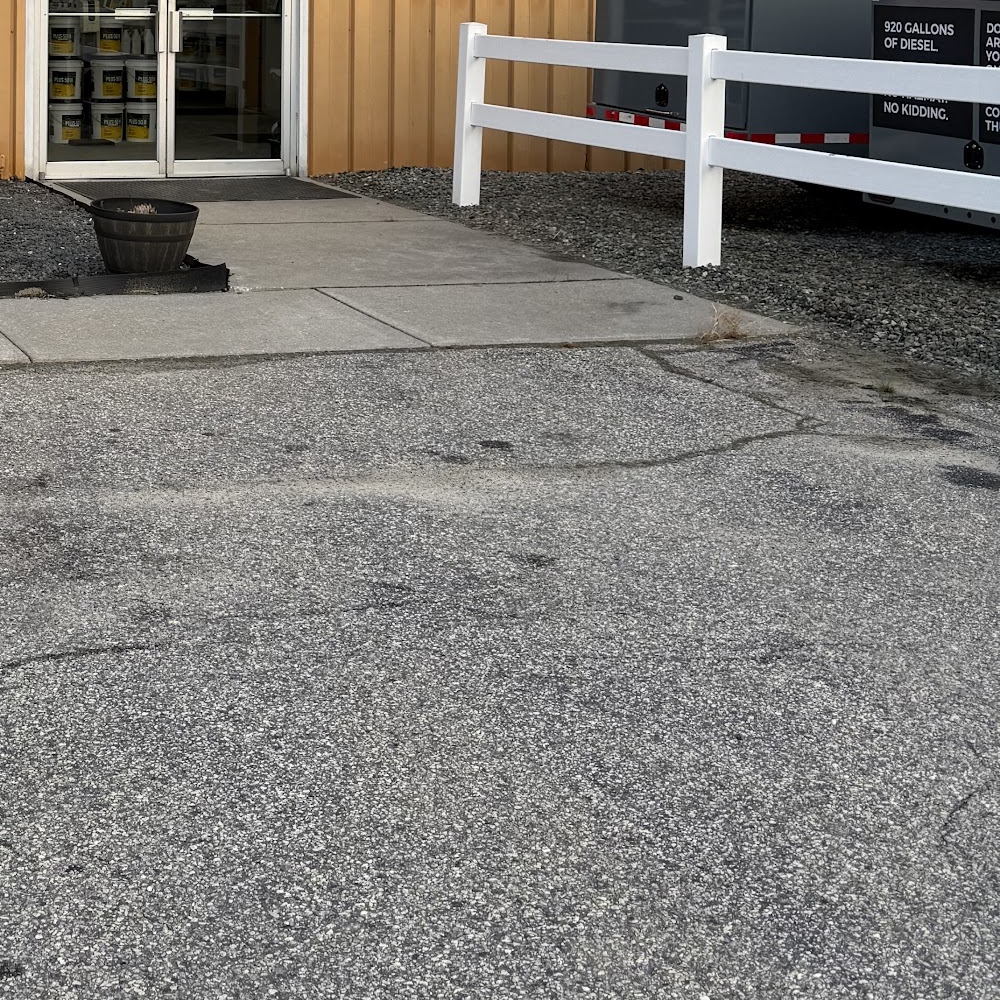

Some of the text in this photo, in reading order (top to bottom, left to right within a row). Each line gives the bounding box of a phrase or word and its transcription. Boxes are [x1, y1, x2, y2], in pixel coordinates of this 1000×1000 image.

[884, 21, 955, 36] 920 GALLONS
[884, 37, 939, 52] OF DIESEL.
[883, 101, 949, 120] NO KIDDING.
[985, 120, 1000, 132] TH
